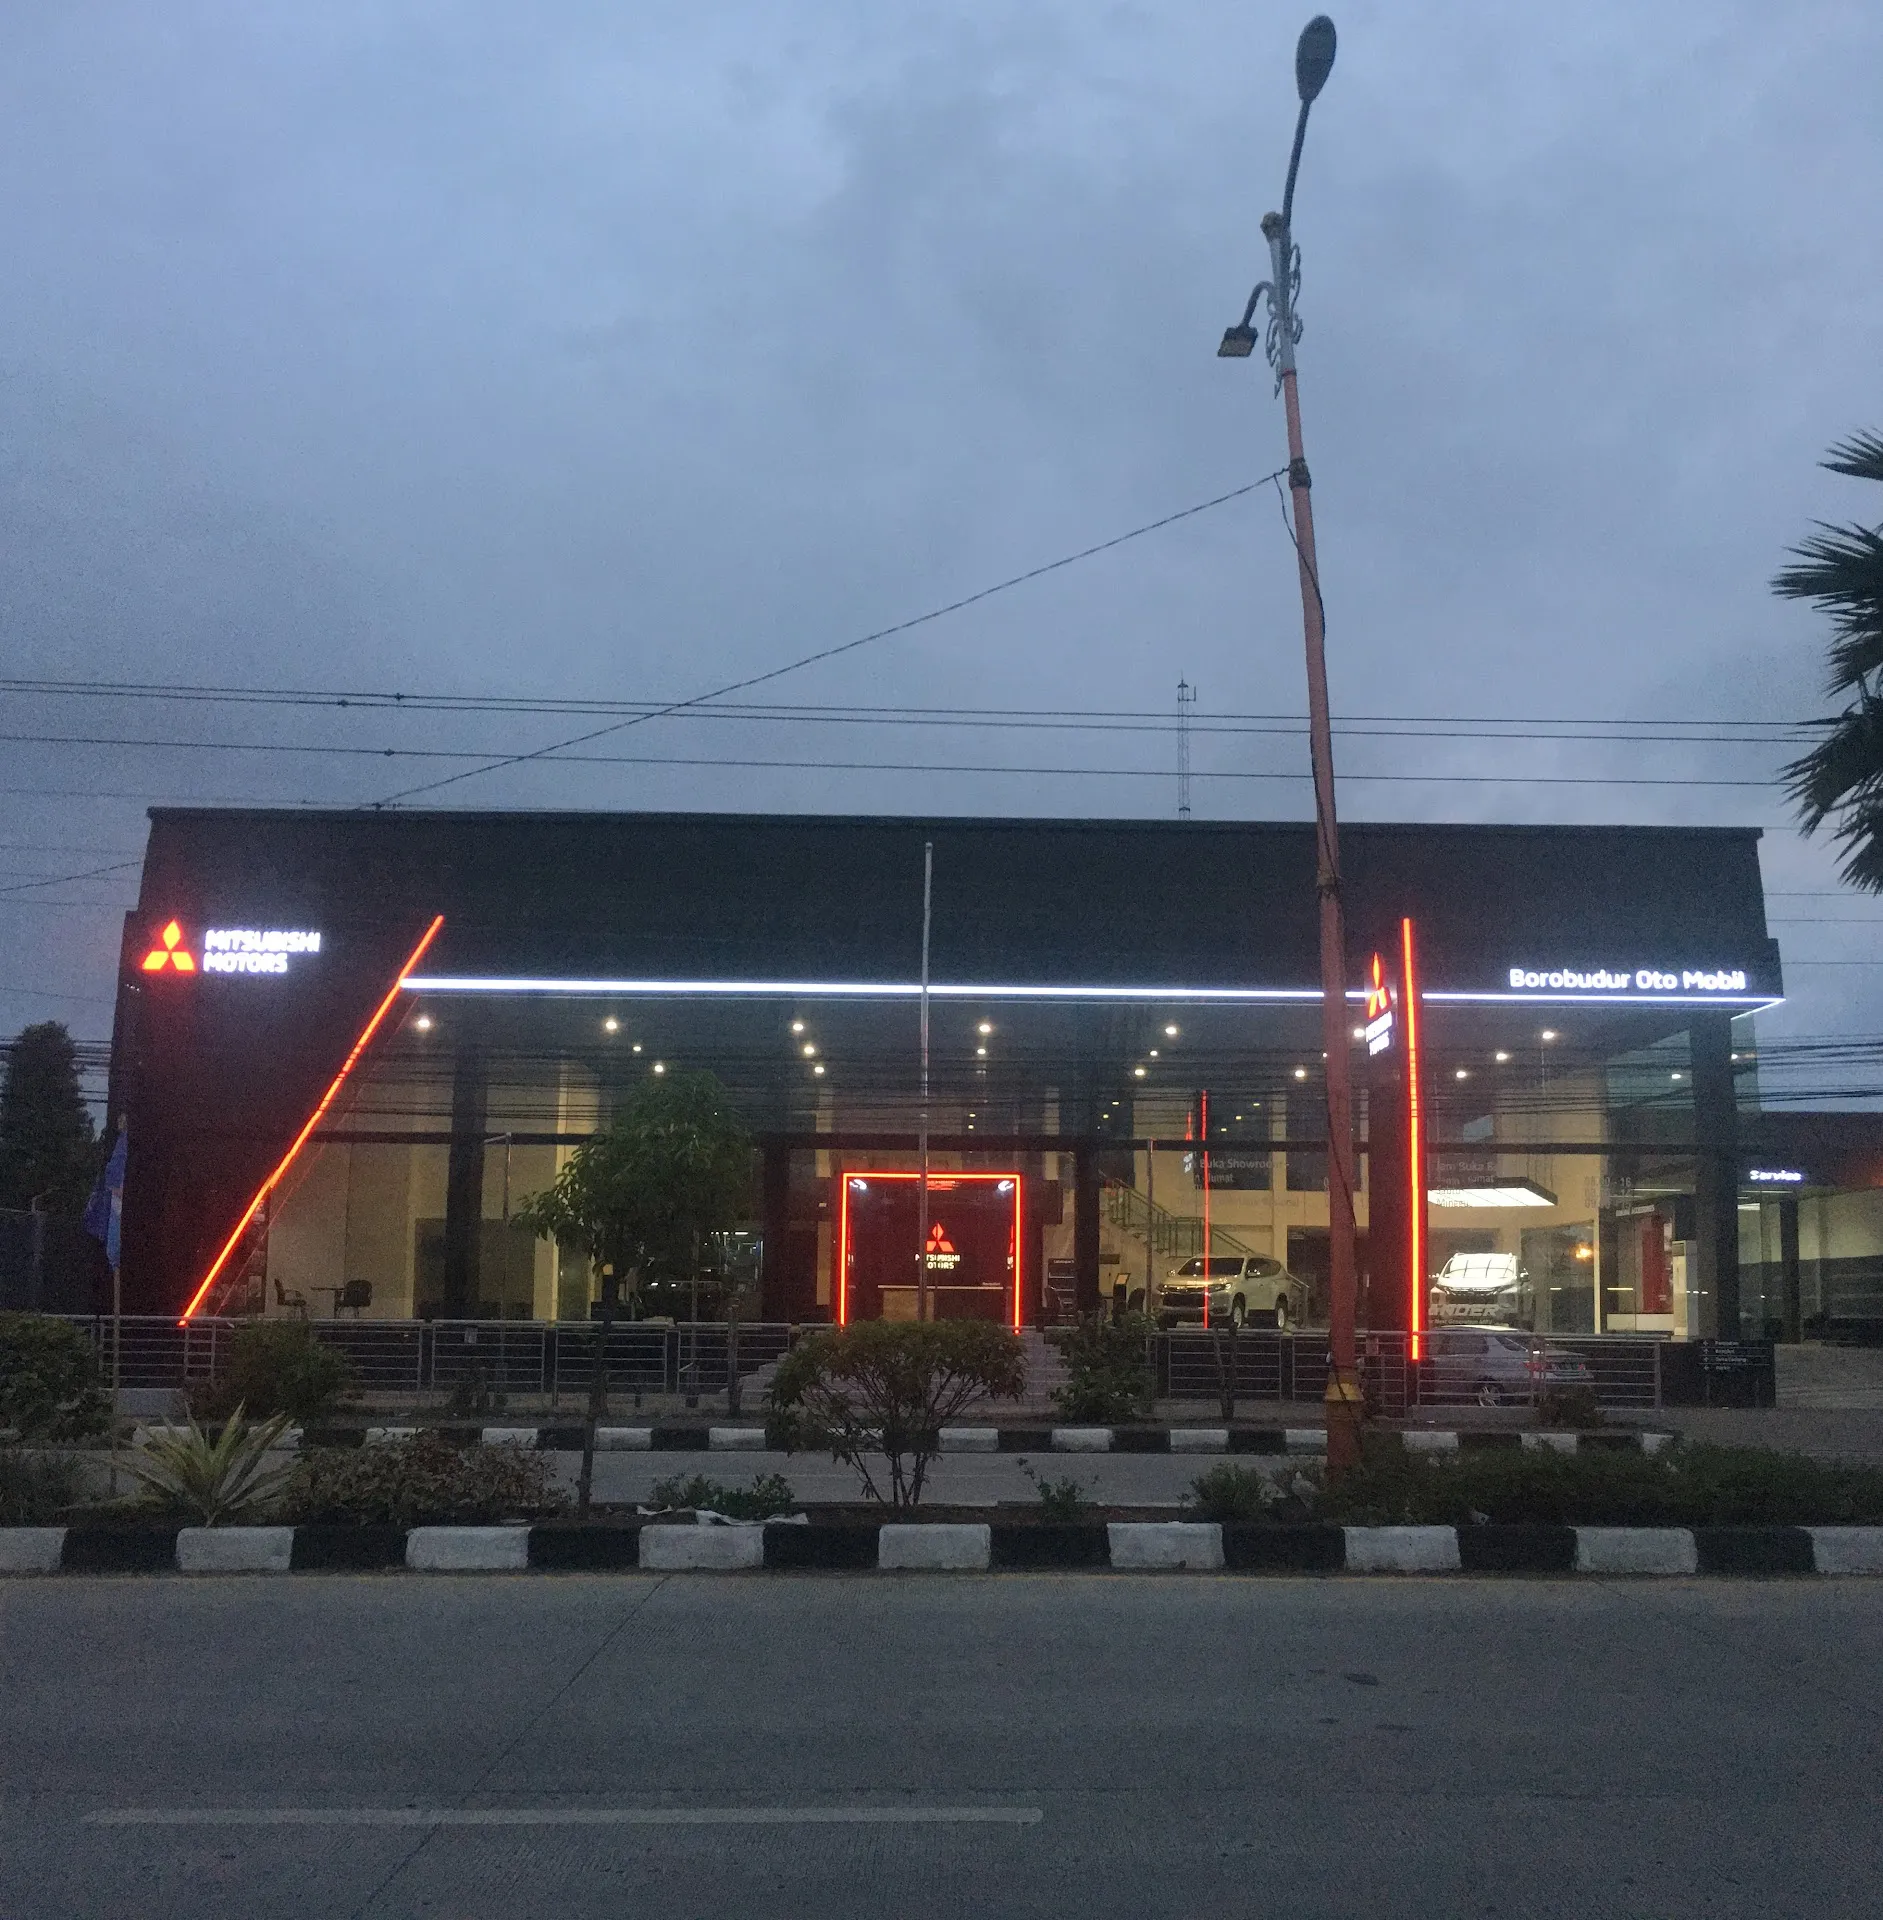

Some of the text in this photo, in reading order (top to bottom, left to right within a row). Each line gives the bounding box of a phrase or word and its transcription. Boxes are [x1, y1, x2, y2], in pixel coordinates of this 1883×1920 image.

[204, 929, 321, 953] MITSUBISHI
[203, 951, 288, 973] MOTORS
[1509, 968, 1746, 990] Borobudur Oto Mobil
